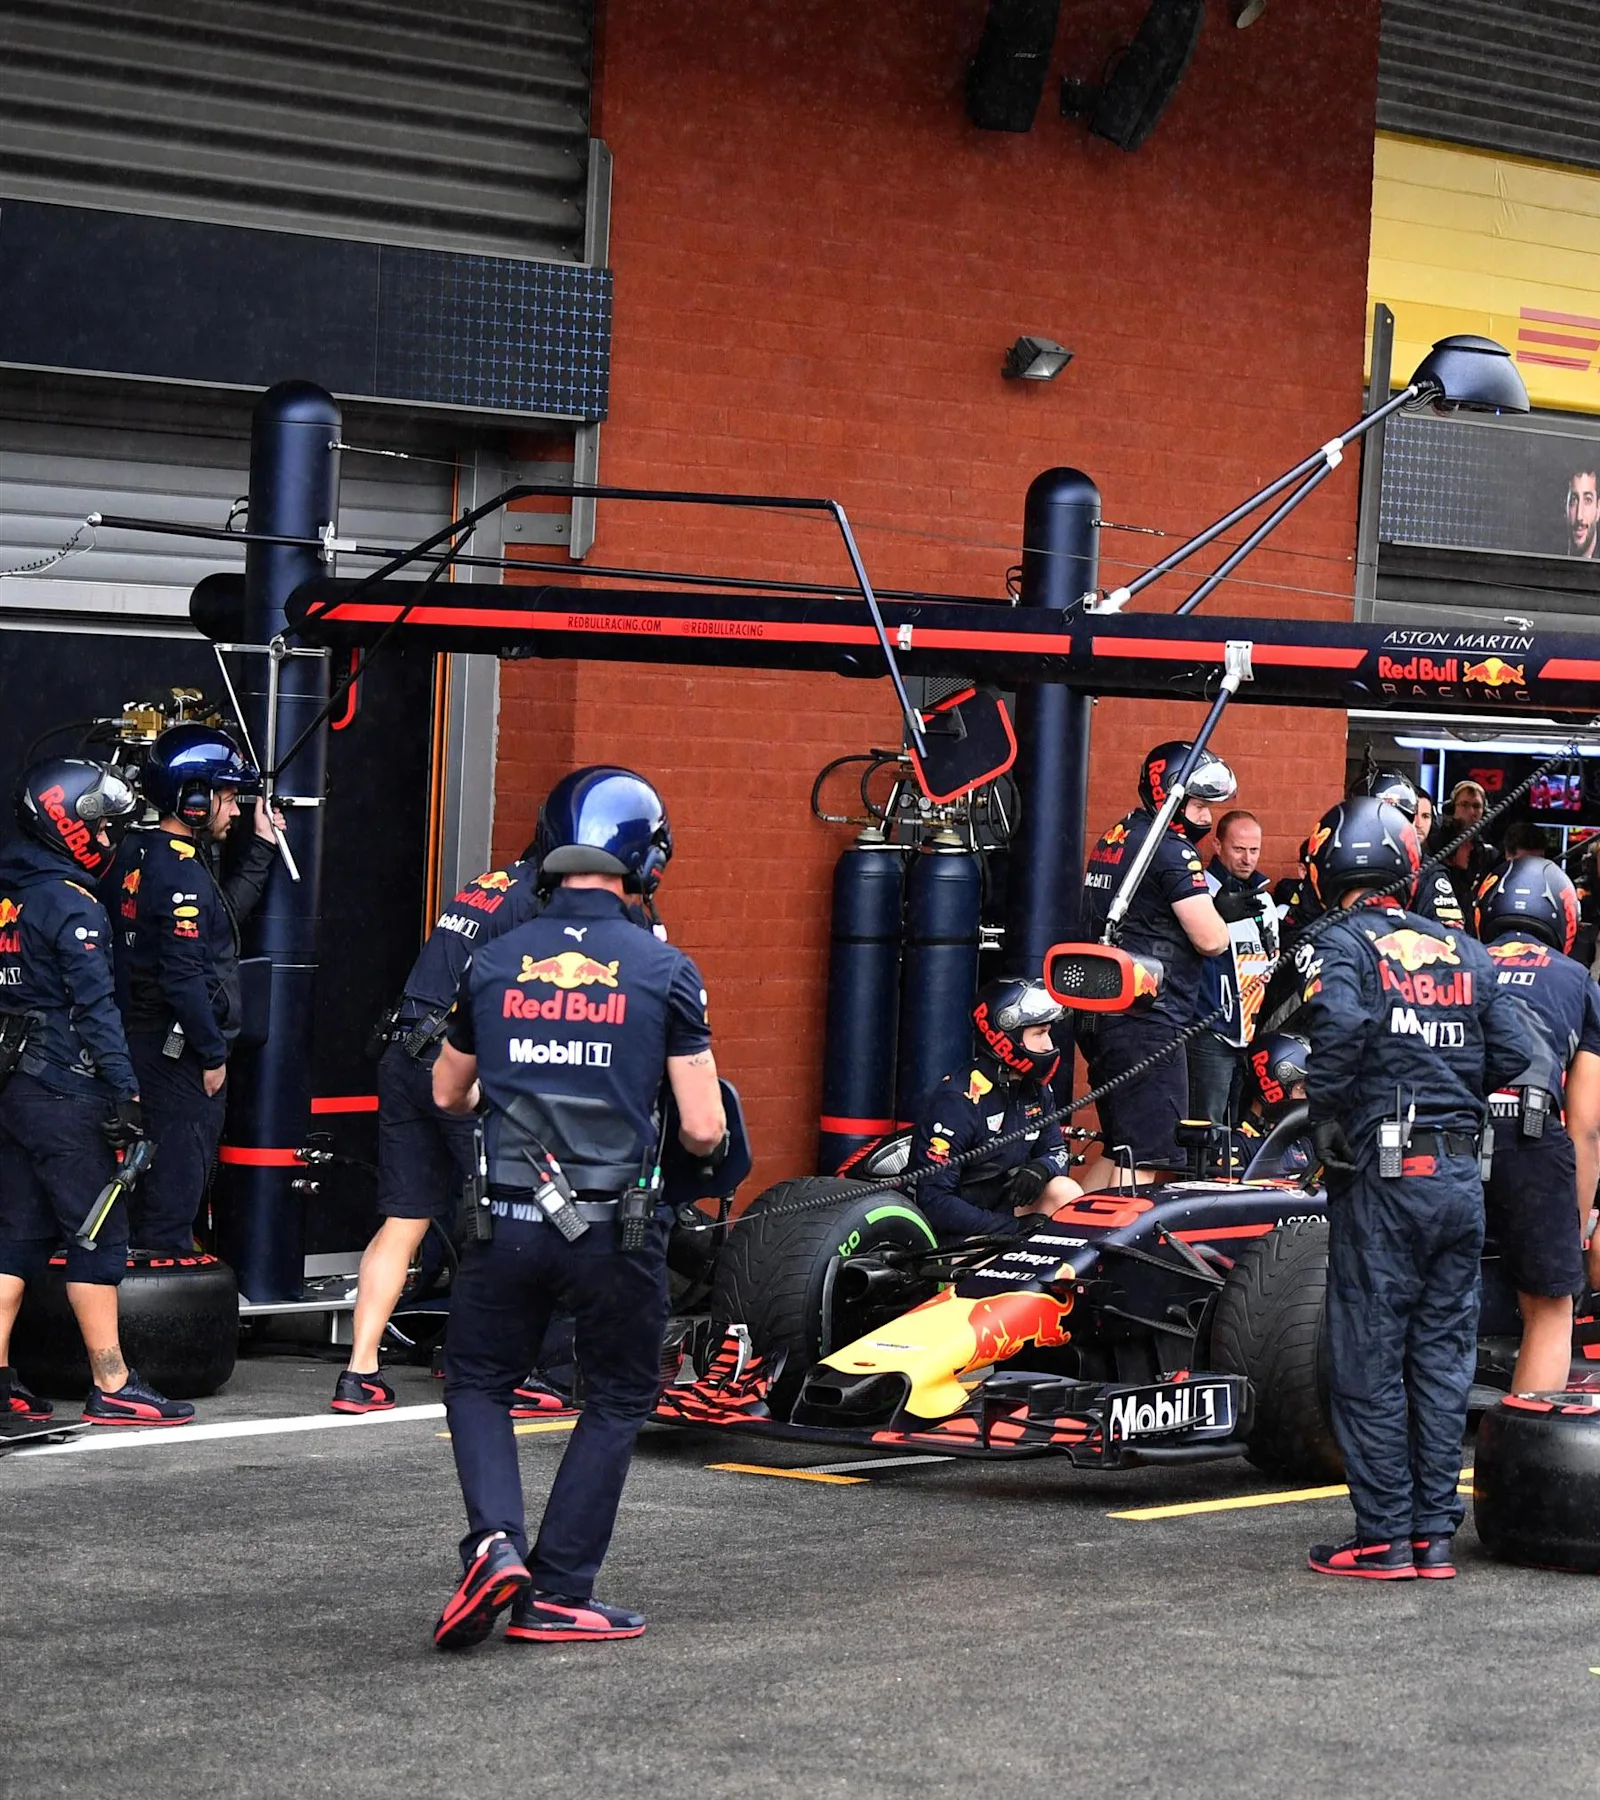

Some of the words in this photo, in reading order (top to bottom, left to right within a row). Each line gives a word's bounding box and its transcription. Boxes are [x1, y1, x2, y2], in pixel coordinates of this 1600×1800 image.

[567, 616, 662, 633] REDBULLRACING.COM
[682, 620, 764, 637] @REDBULLRACING
[1384, 631, 1450, 646] ASTON
[1454, 634, 1534, 650] MARTIN
[1378, 656, 1418, 680] Red
[1419, 658, 1458, 682] Bull
[1382, 683, 1531, 701] RACING
[38, 784, 84, 837] Red
[64, 822, 104, 870] Bull
[1413, 972, 1473, 1006] Bull
[503, 989, 563, 1020] Red
[565, 992, 627, 1025] Bull
[509, 1038, 583, 1065] Mobil
[973, 1002, 1005, 1046] Red
[993, 1037, 1034, 1073] Bull
[1252, 1050, 1279, 1091] Red
[974, 1268, 1018, 1280] Mobil
[1109, 1388, 1191, 1441] Mobil
